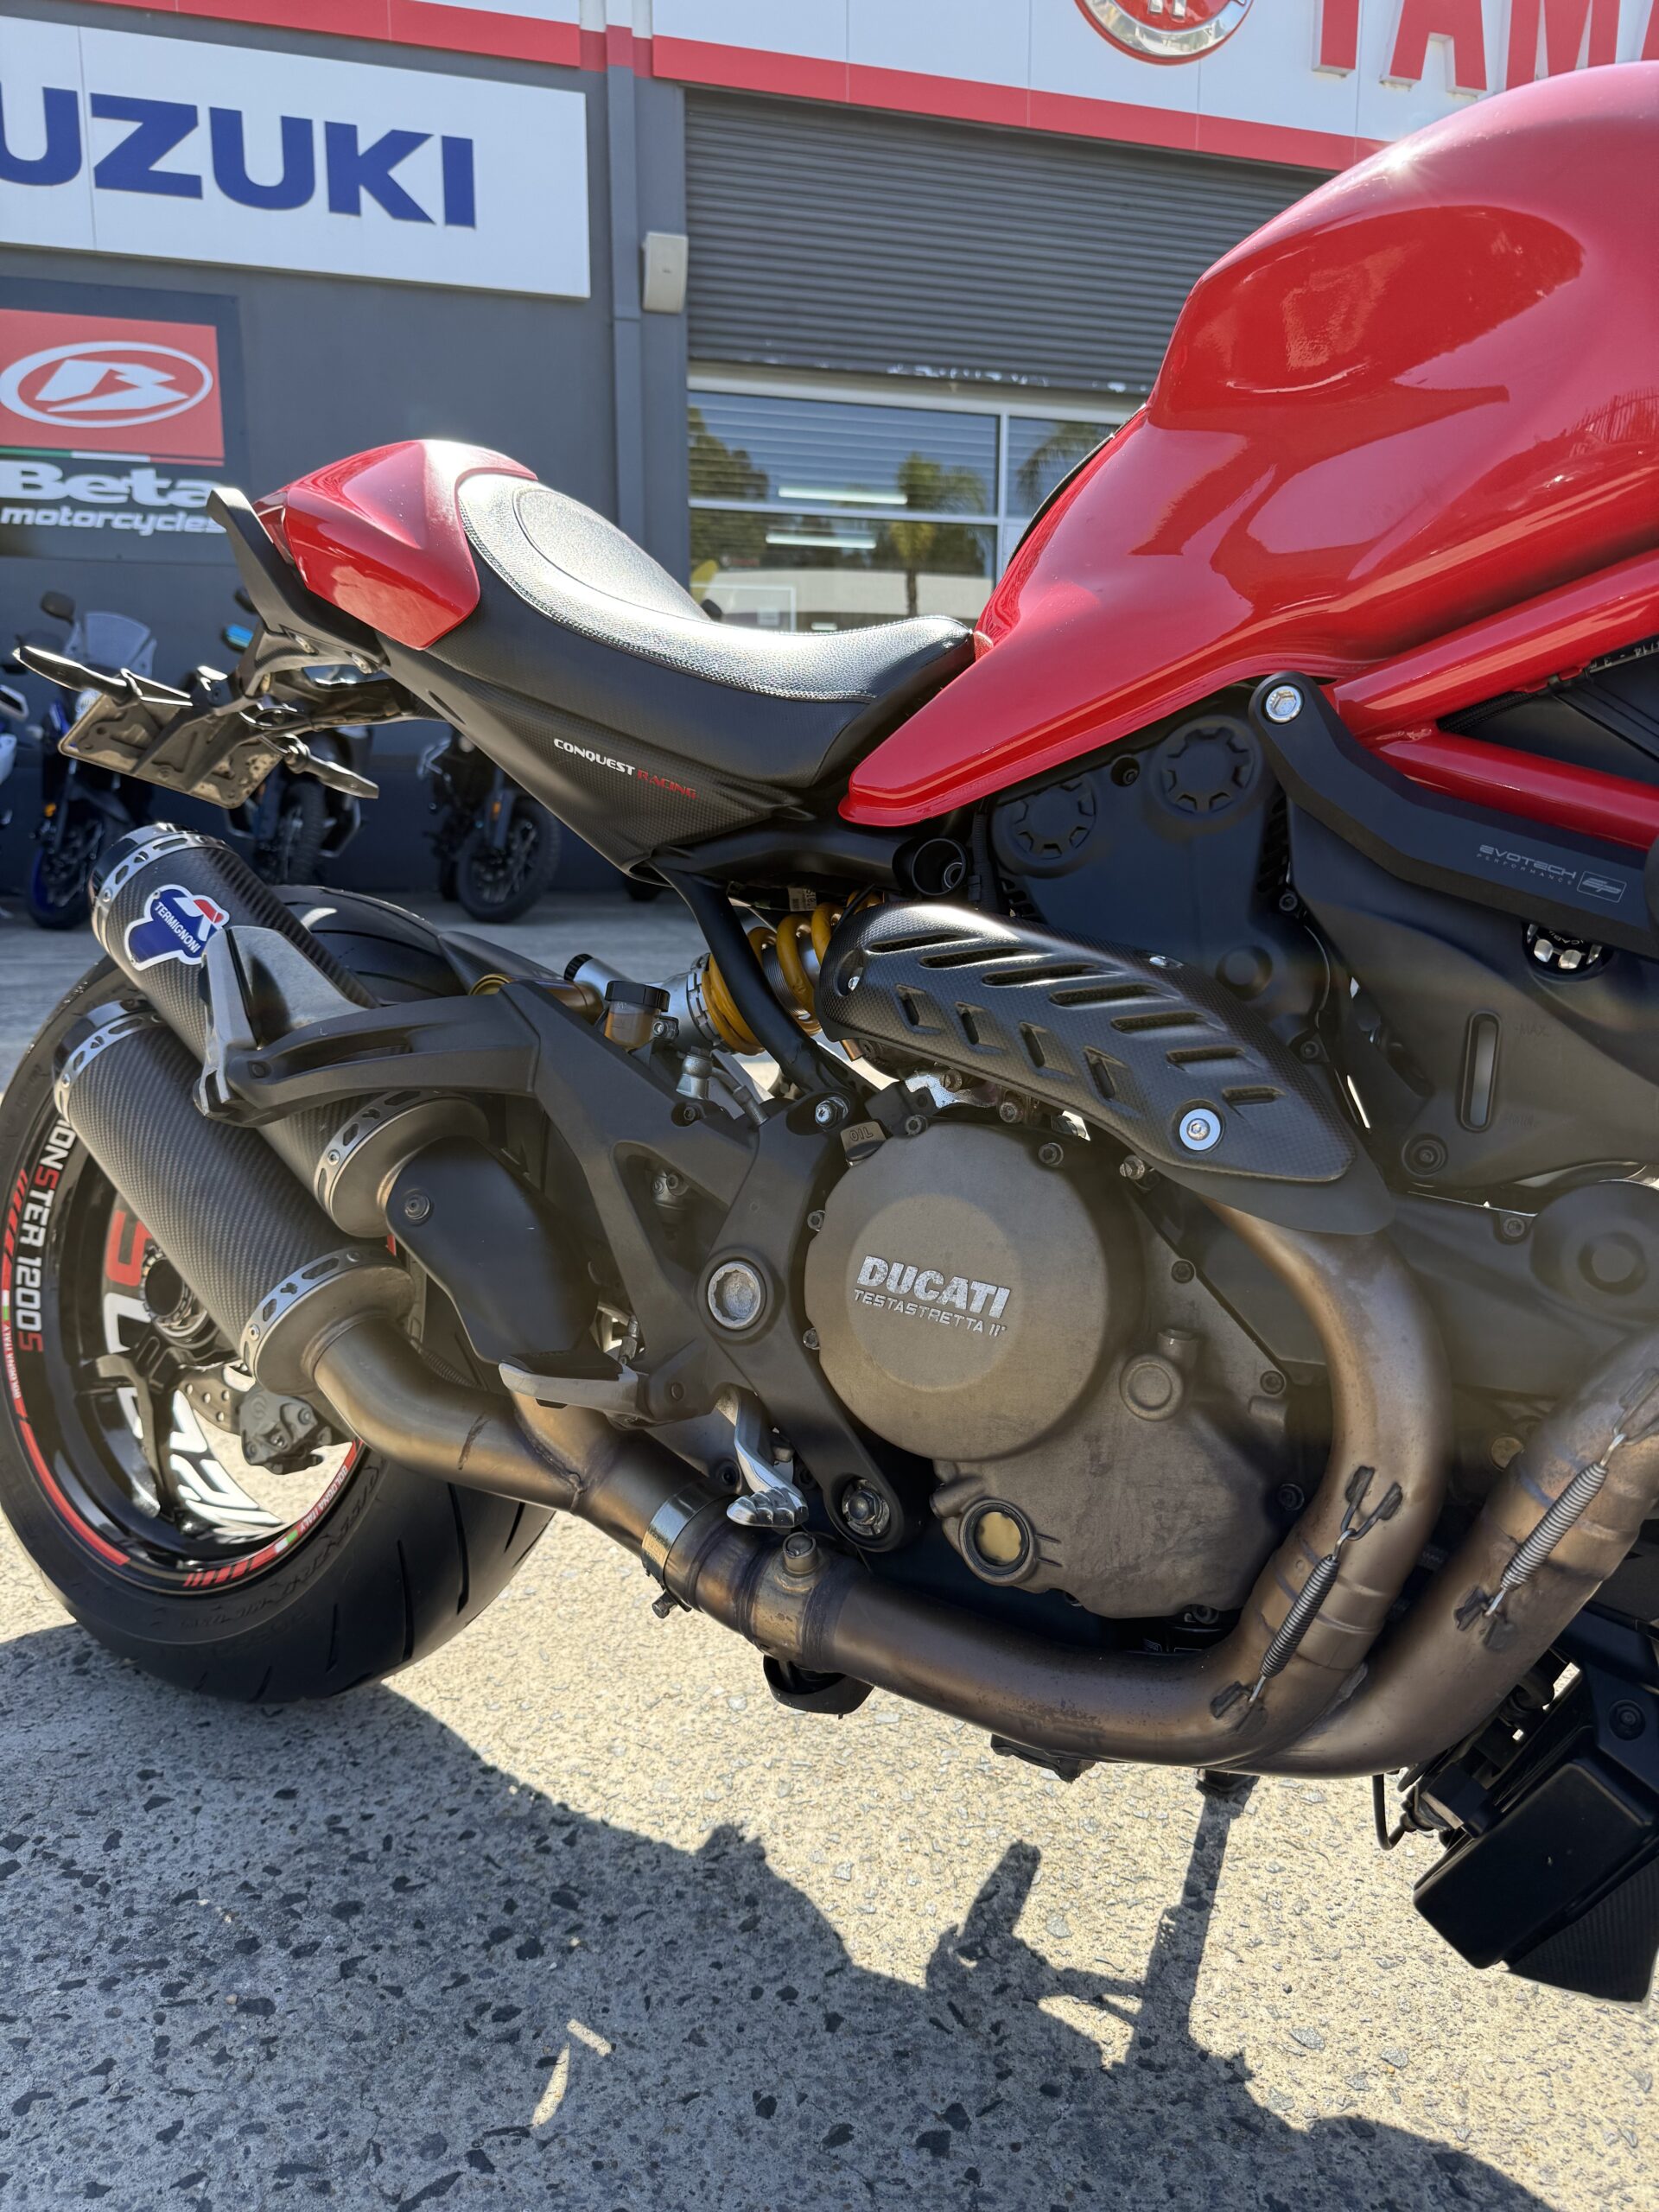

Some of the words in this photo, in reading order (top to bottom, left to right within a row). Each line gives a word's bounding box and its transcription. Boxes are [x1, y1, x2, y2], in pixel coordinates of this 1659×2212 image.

[0, 459, 223, 508] Beta
[0, 505, 227, 537] motorcycles
[553, 738, 636, 776] CONQUEST
[636, 768, 698, 800] RACING
[1476, 853, 1573, 886] PERFORMANCE
[1478, 844, 1577, 880] EVOTECH
[154, 901, 201, 953] TERMIGNONI
[849, 1126, 874, 1142] OIL
[15, 1255, 45, 1352] 1200S
[856, 1255, 1011, 1319] DUCATI
[853, 1287, 984, 1334] TESTASTRETTA
[2, 1324, 13, 1351] ITALY
[318, 1465, 348, 1510] BOLOGNA
[300, 1507, 320, 1533] ITALY
